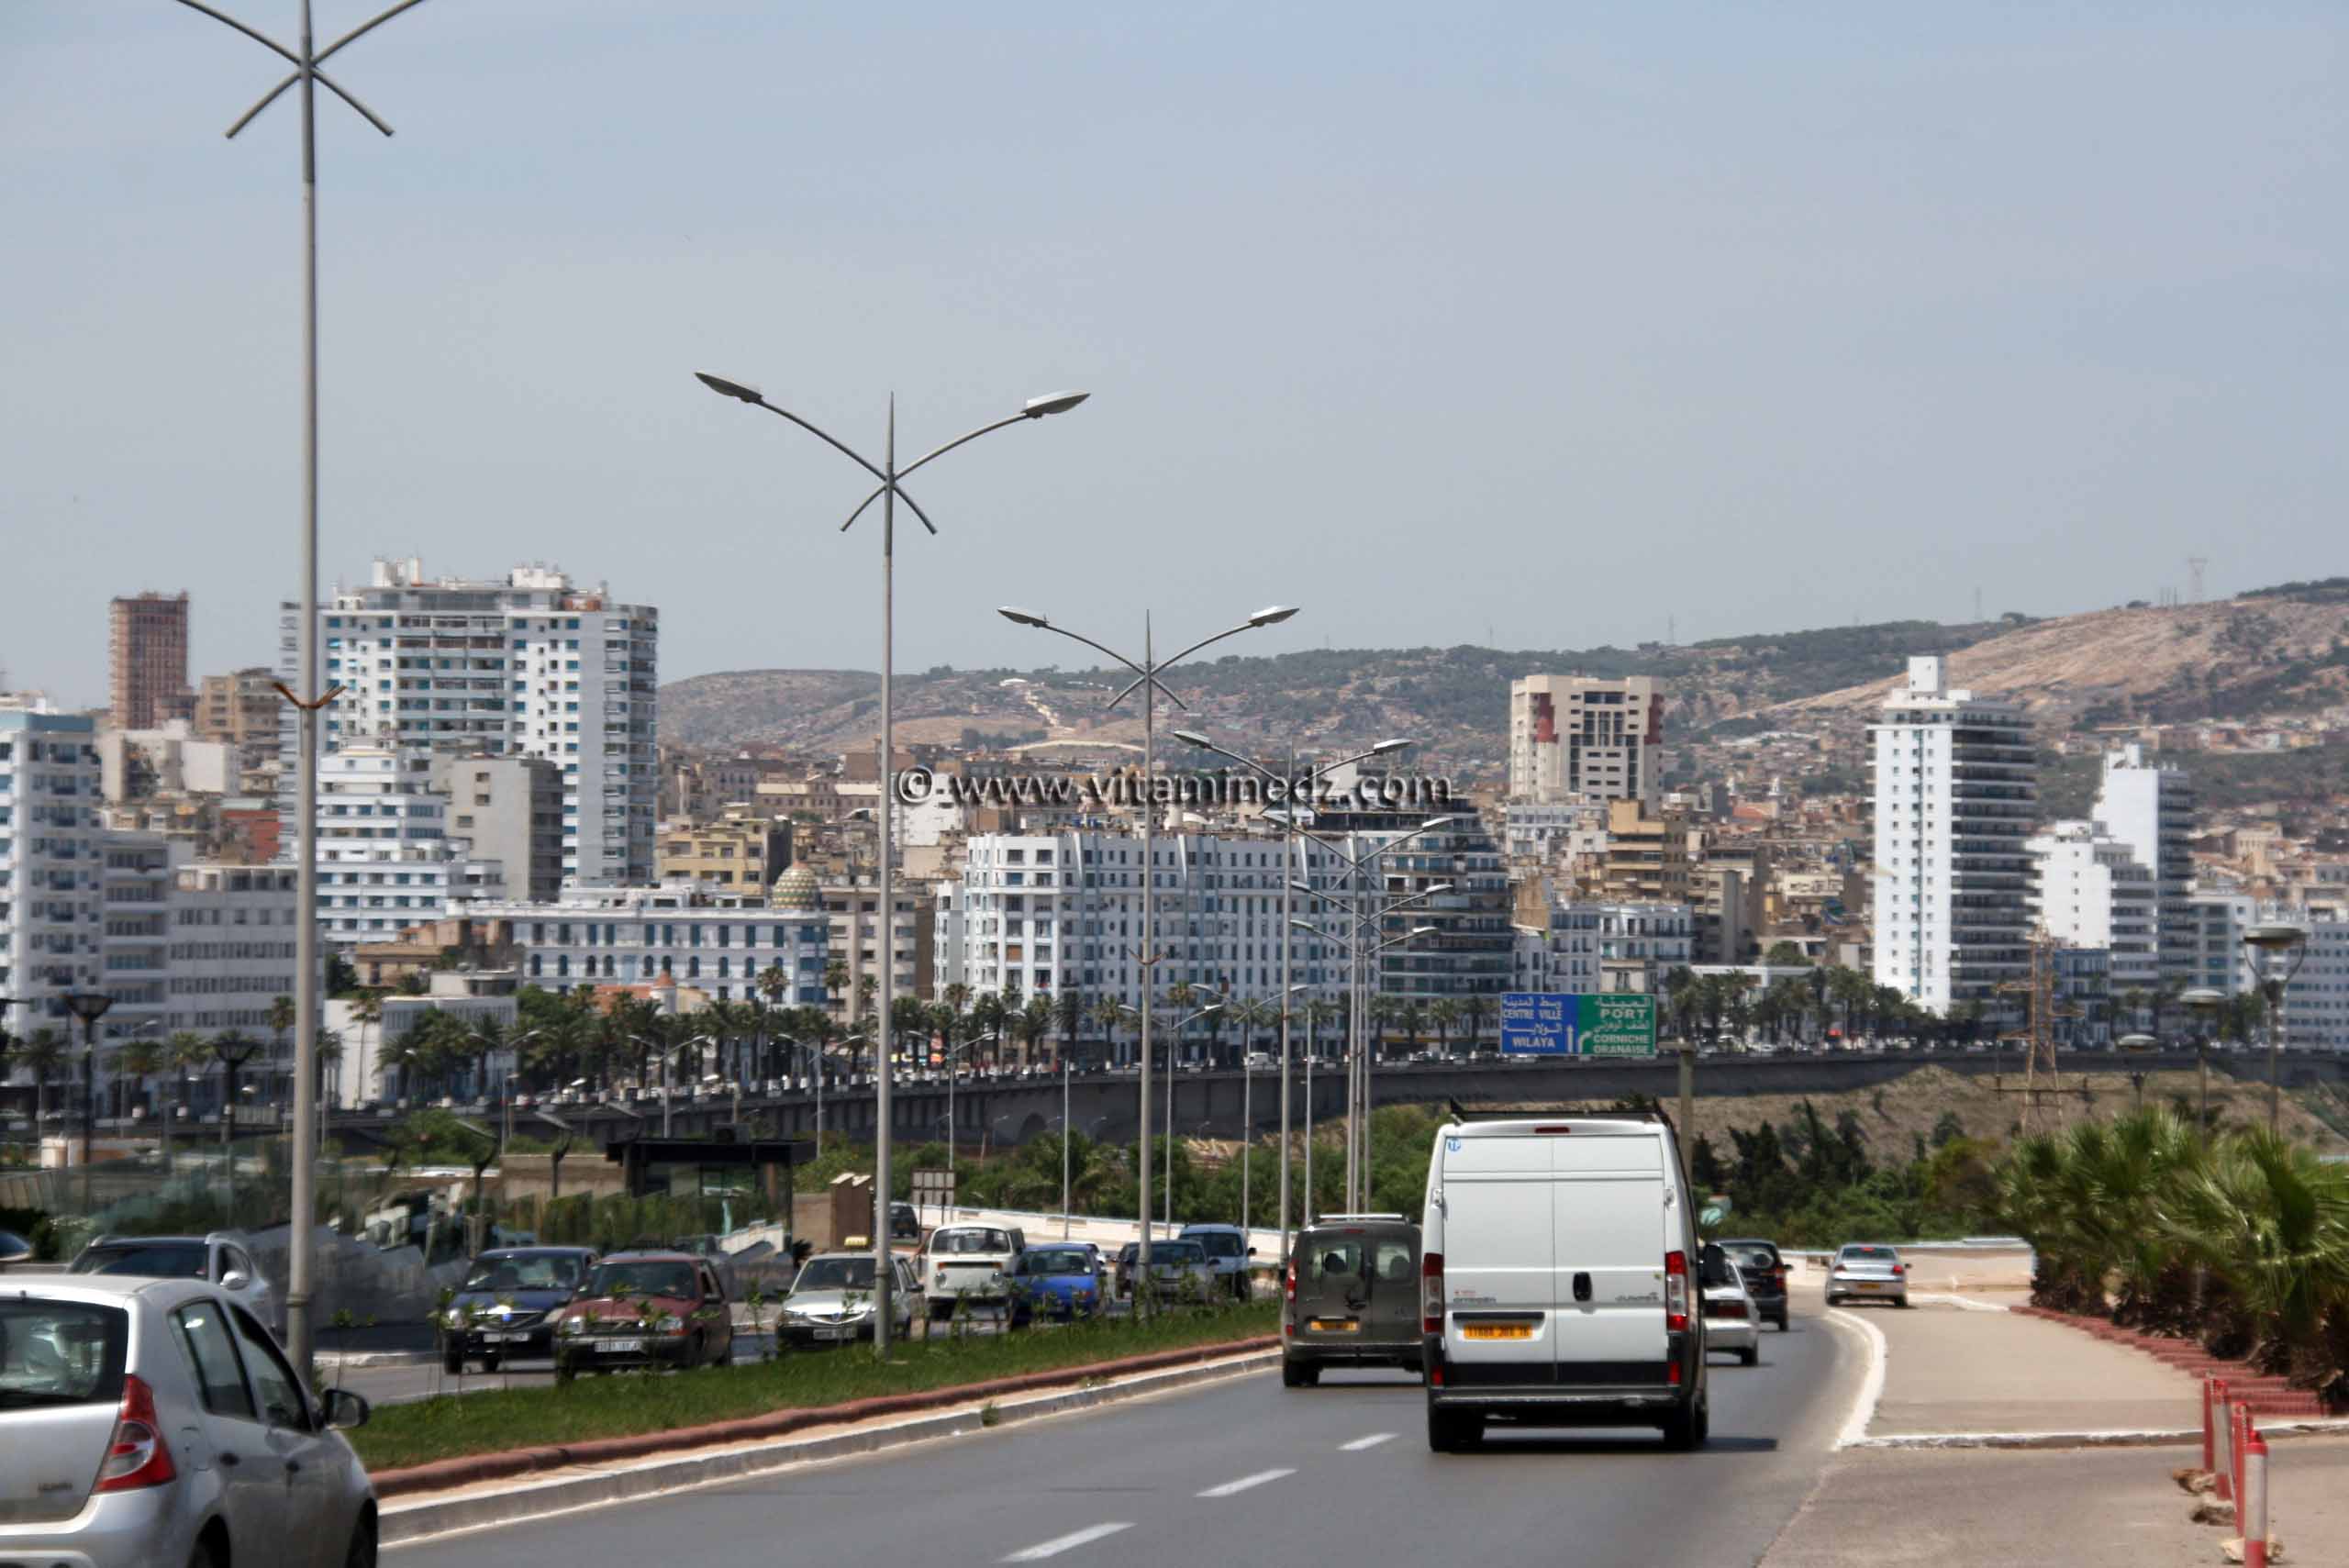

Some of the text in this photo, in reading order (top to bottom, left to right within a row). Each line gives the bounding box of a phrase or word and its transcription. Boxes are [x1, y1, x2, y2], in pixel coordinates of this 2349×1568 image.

[1503, 1009, 1563, 1020] CENTRE VILLE
[1599, 1009, 1647, 1018] PORT
[1512, 1037, 1556, 1049] WILAYA
[1593, 1034, 1650, 1044] CORNICHE
[1593, 1045, 1650, 1055] ORANAISE
